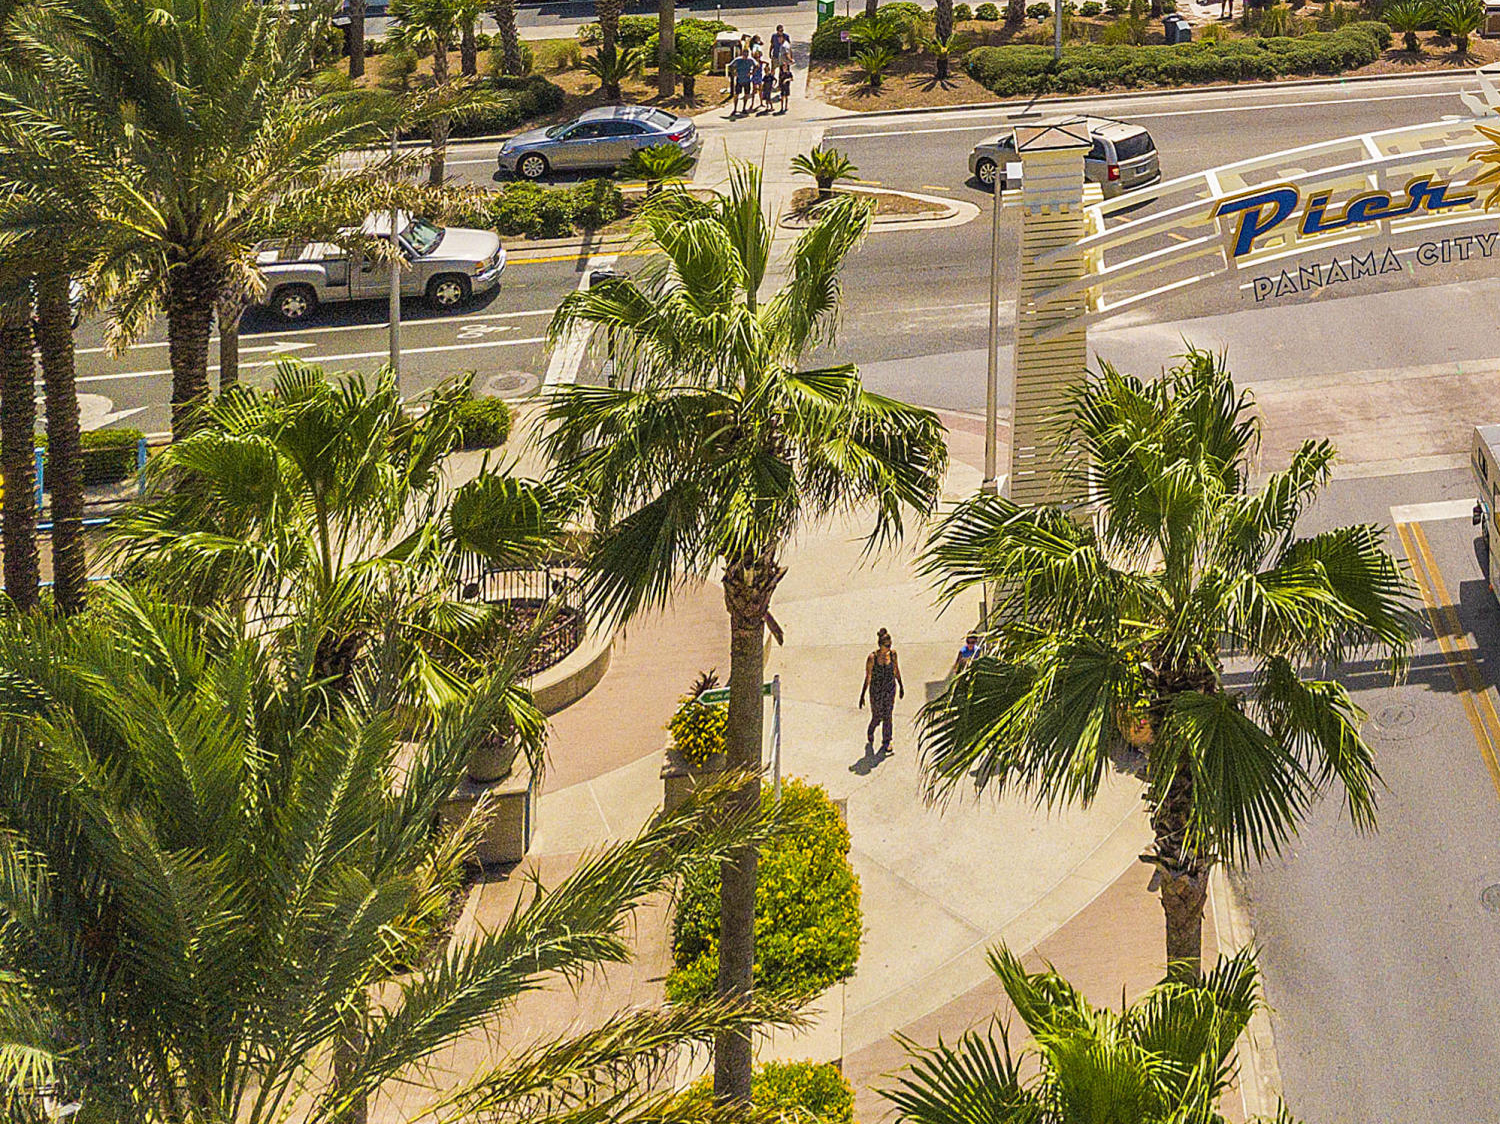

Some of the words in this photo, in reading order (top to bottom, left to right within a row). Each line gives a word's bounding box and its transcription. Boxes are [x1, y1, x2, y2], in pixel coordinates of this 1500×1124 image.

[1208, 173, 1478, 257] Pier
[1253, 247, 1402, 302] PANAMA
[1416, 232, 1499, 266] CITY
